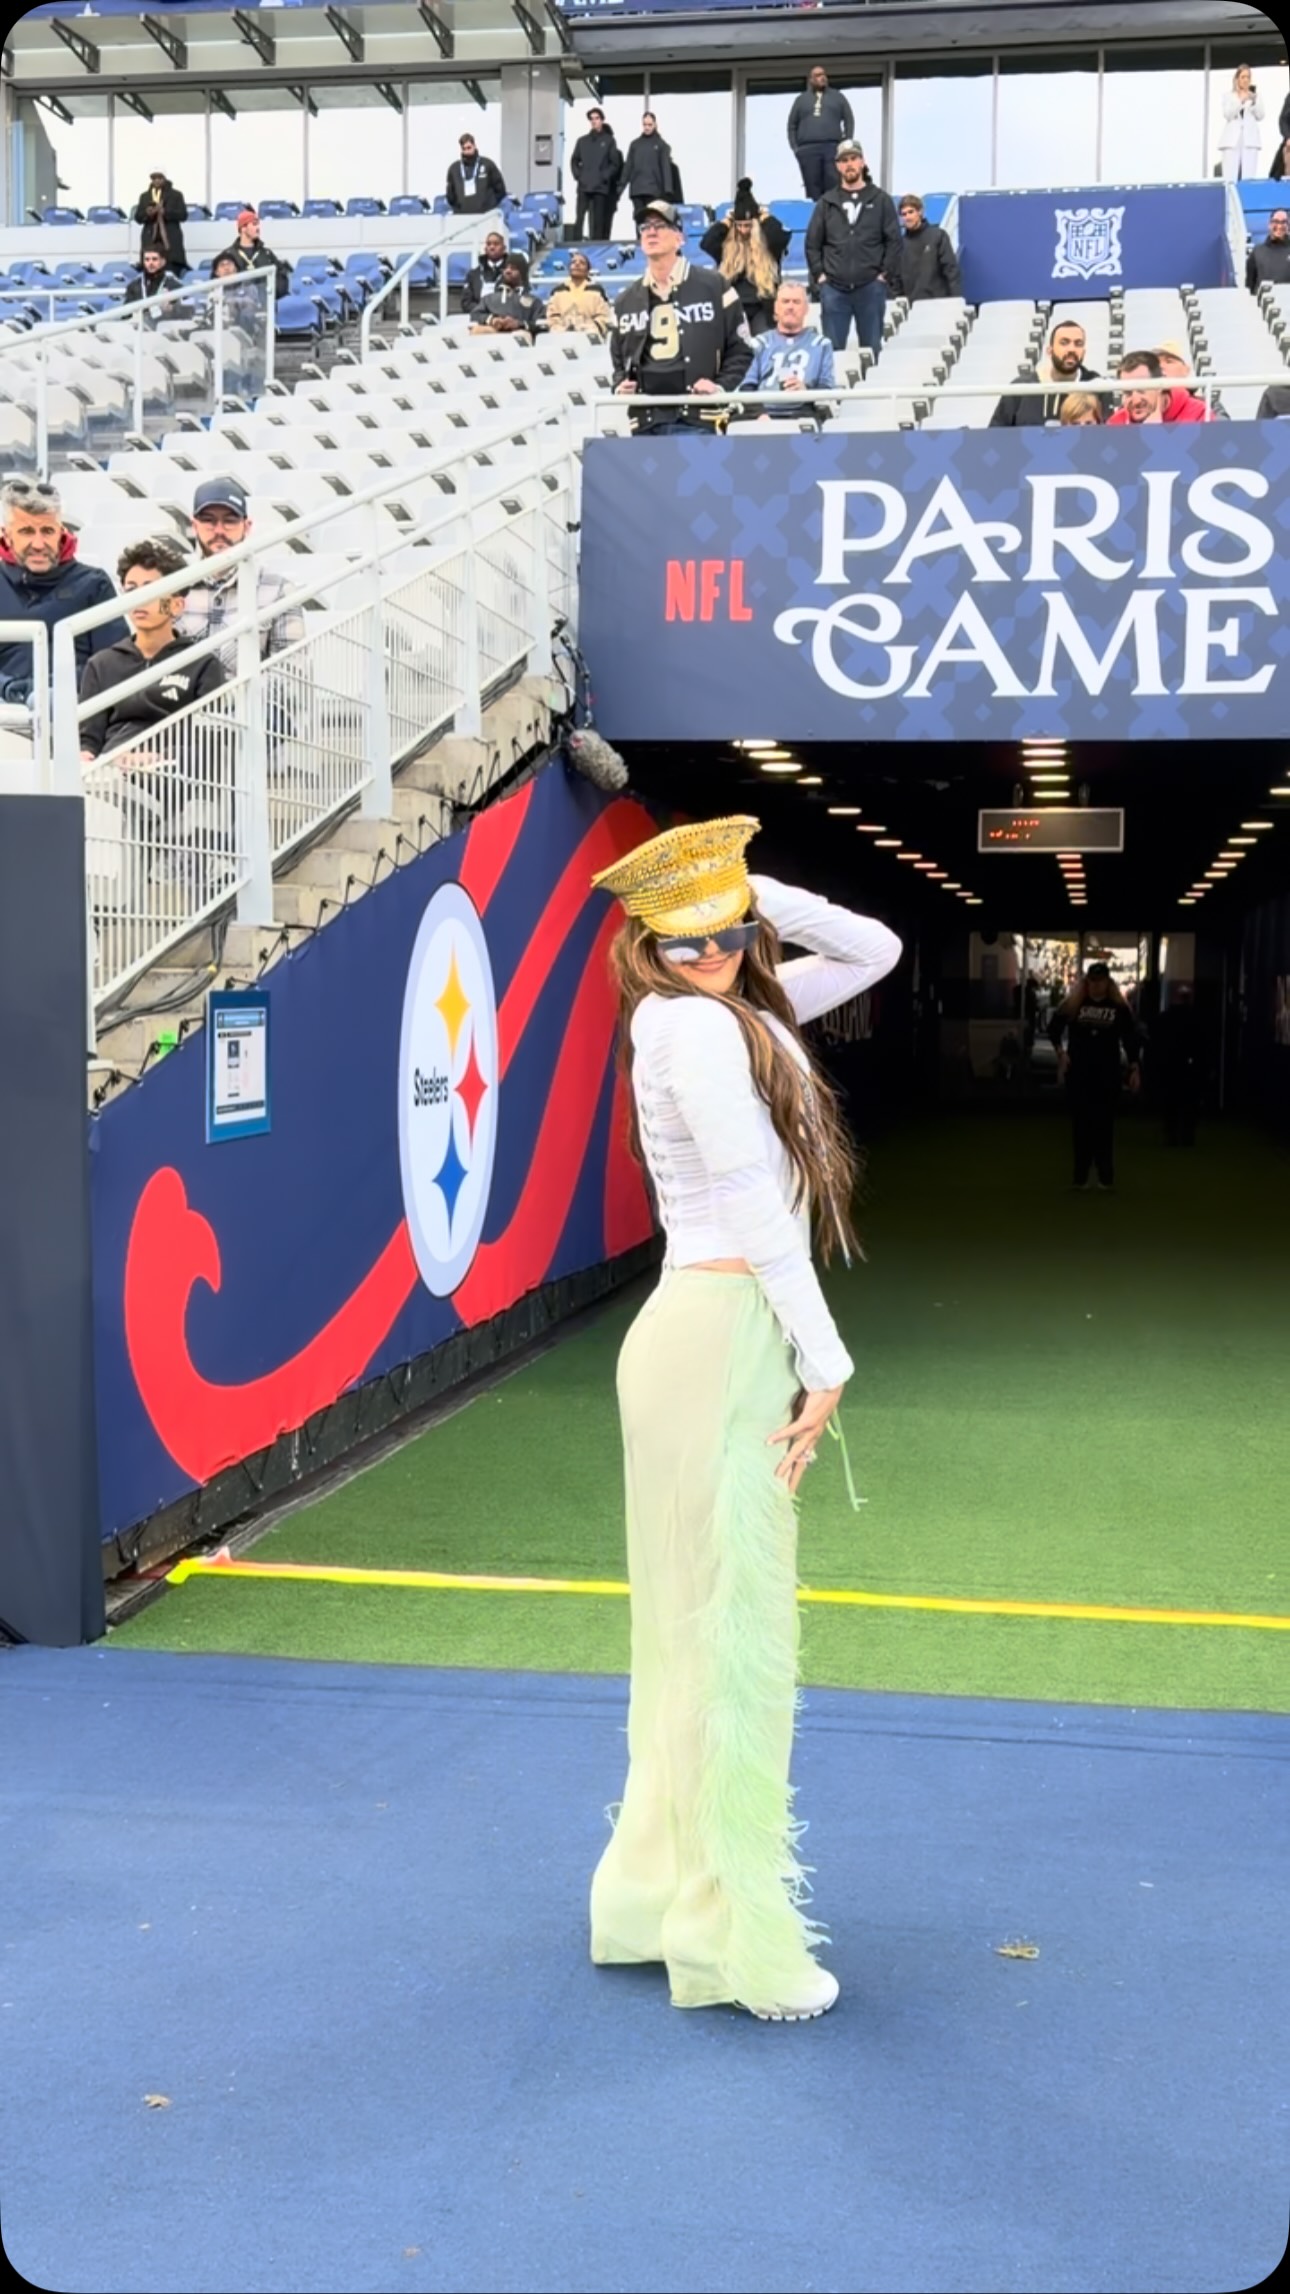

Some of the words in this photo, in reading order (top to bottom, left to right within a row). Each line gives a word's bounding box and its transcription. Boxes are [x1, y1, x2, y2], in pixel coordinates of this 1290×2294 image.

[1073, 239, 1103, 260] NFL
[650, 304, 680, 360] 9
[815, 467, 1275, 584] PARIS
[665, 560, 753, 623] NFL
[773, 586, 1279, 699] GAME
[414, 1067, 448, 1107] Steelers
